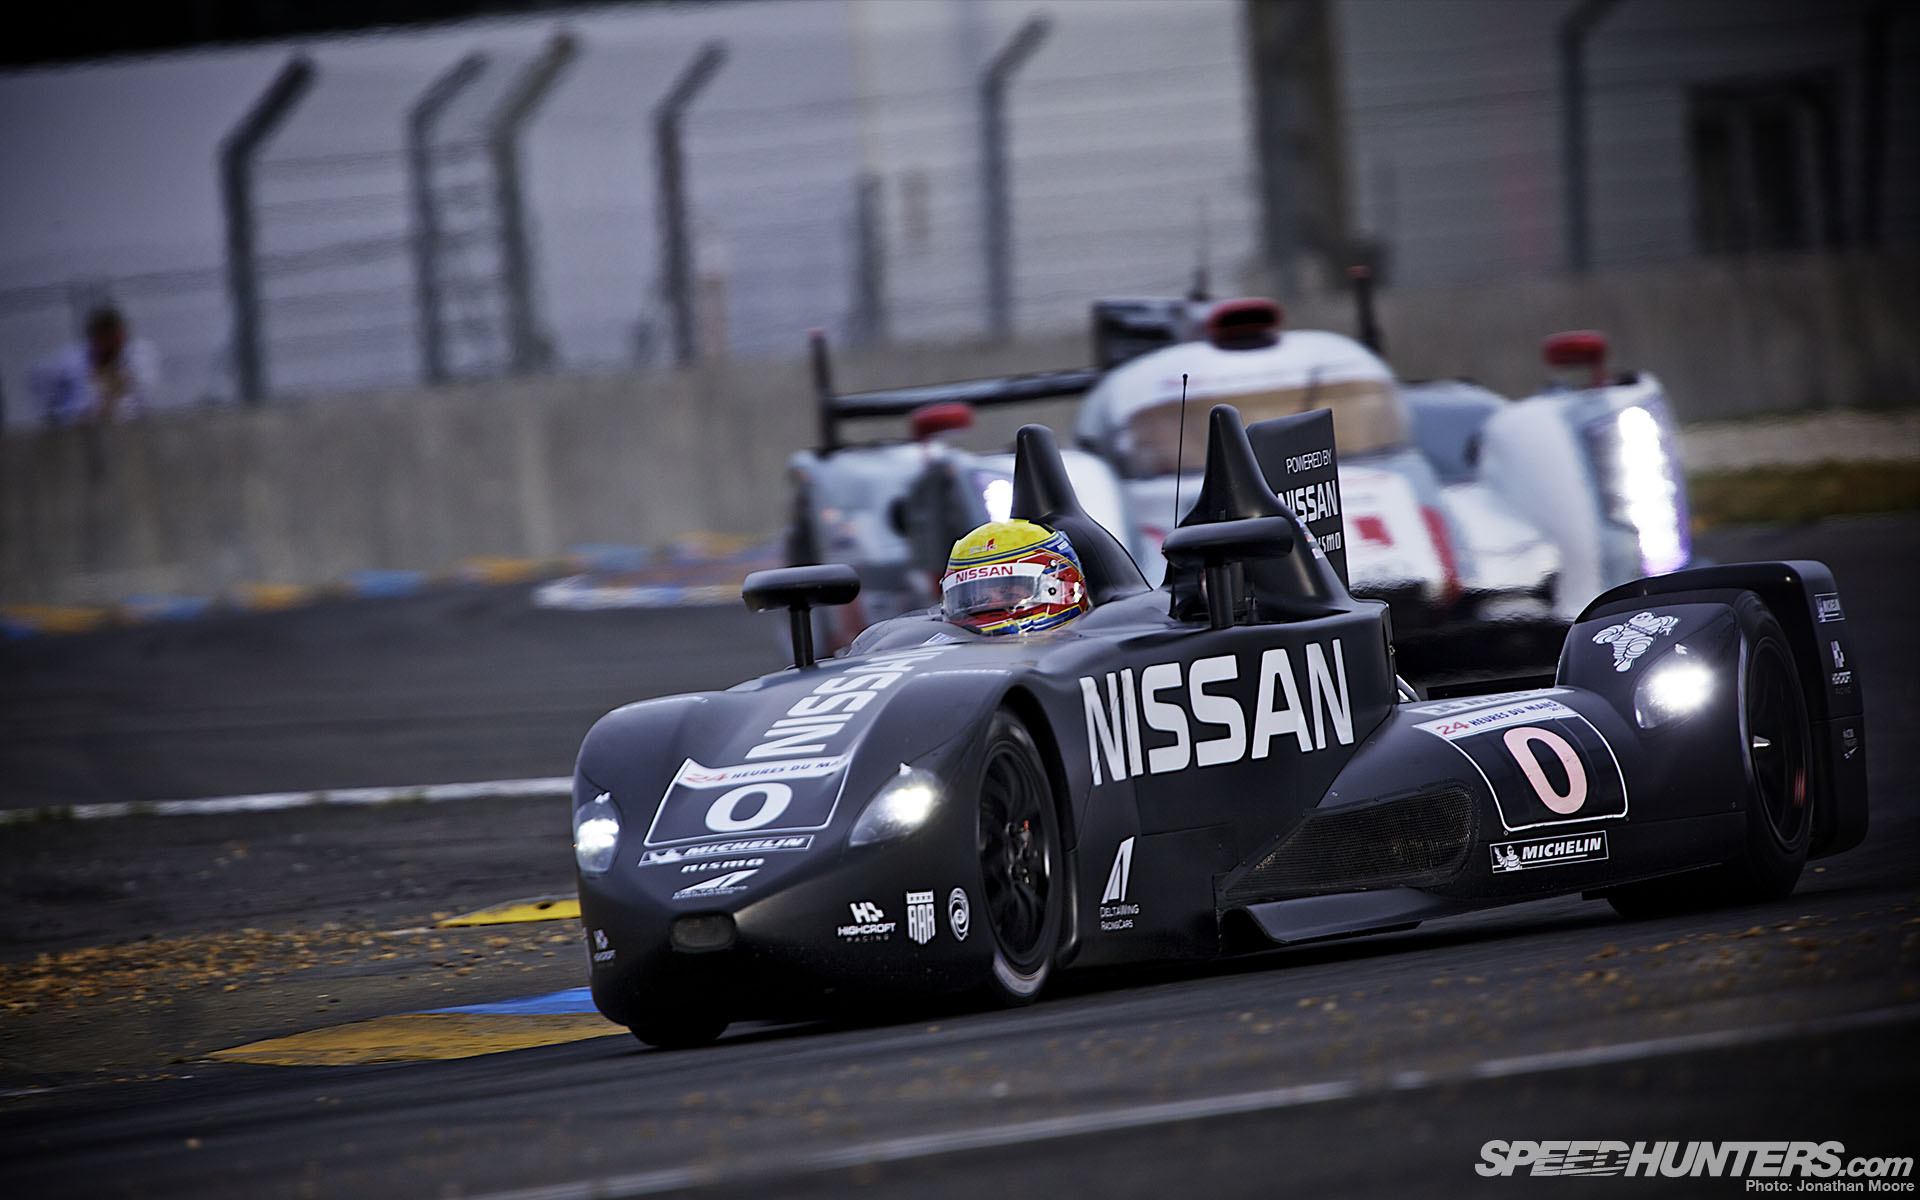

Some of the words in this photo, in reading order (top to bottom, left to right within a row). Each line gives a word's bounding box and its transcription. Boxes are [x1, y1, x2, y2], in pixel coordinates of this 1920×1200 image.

[1286, 451, 1322, 474] POWERED
[1322, 449, 1332, 465] BY
[955, 565, 1013, 584] NISSAN
[1079, 638, 1354, 786] NISSAN
[1436, 721, 1469, 735] 24
[1468, 712, 1509, 727] HEURES
[1510, 707, 1525, 716] DU
[1525, 701, 1558, 713] MANS
[684, 773, 728, 783] 24
[731, 767, 785, 779] HEURES
[790, 763, 811, 772] DU
[1503, 726, 1588, 815] 0
[705, 782, 793, 833] 0
[684, 837, 805, 856] MICHELIN
[1522, 837, 1602, 860] MICHELIN
[837, 922, 896, 937] HIGHCROFT
[846, 933, 890, 944] RACING
